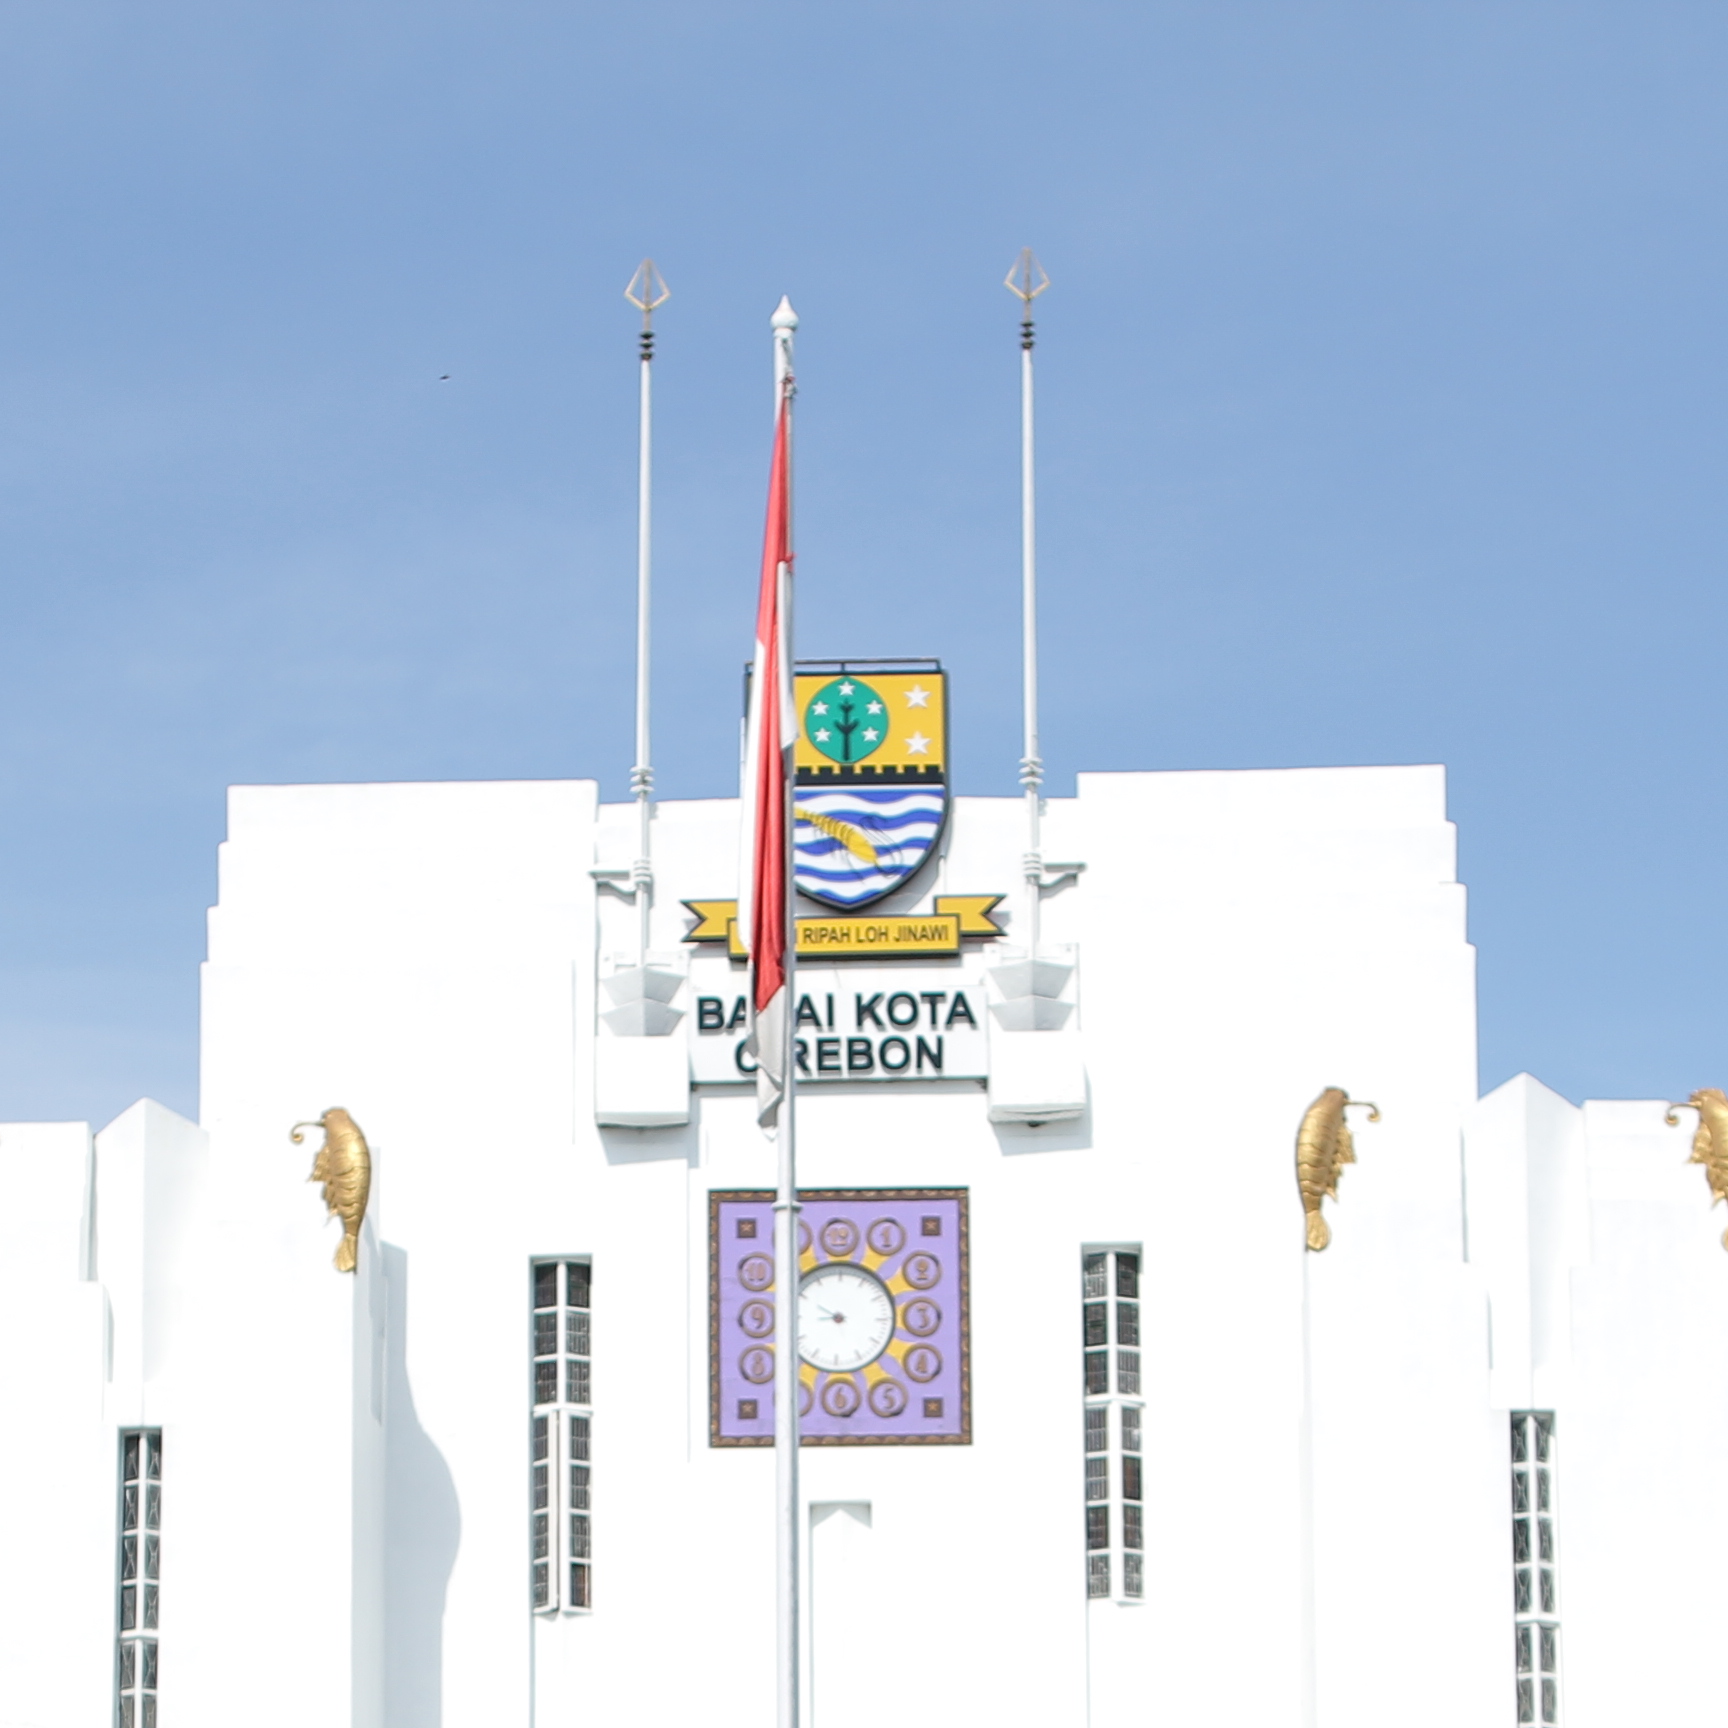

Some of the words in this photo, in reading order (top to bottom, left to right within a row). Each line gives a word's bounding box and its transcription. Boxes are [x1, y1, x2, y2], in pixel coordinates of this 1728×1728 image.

[802, 925, 851, 944] RIPAH
[856, 925, 889, 943] LOH
[893, 923, 949, 942] JINAWI
[696, 992, 835, 1030] BAAI
[855, 991, 977, 1027] KOTA
[735, 1035, 944, 1073] CREBON
